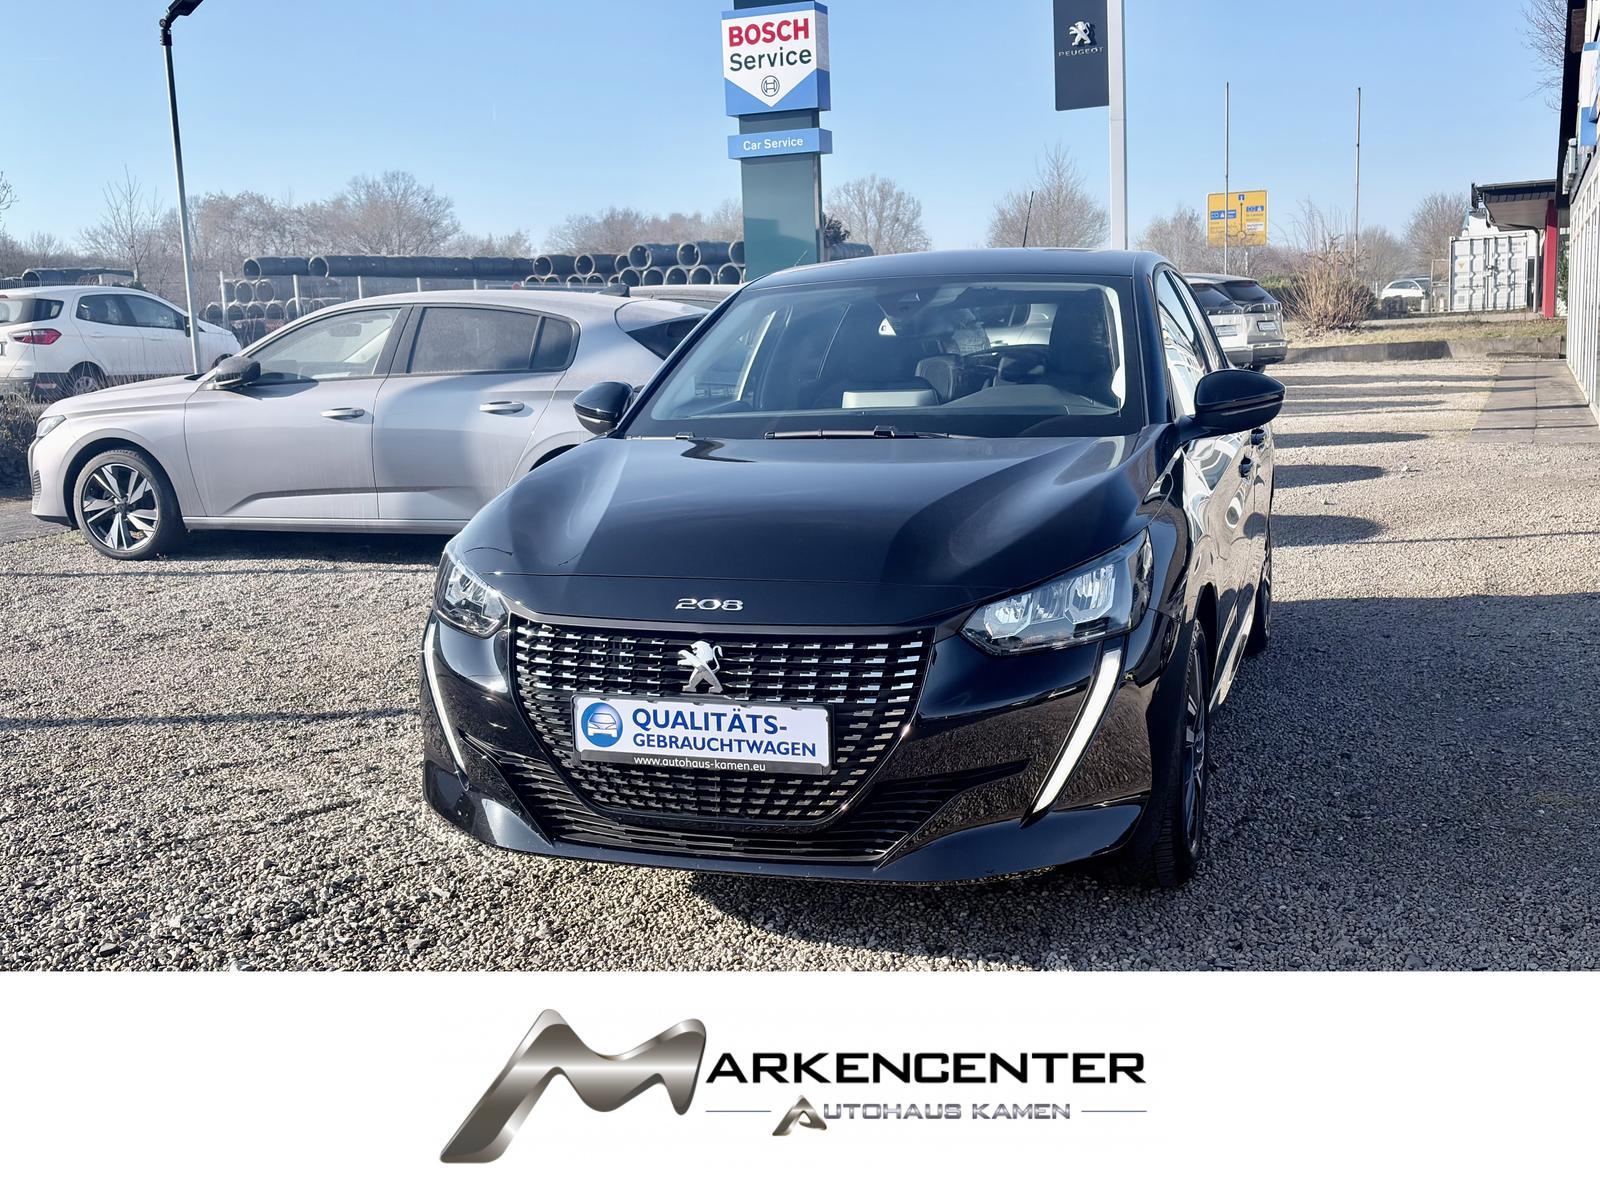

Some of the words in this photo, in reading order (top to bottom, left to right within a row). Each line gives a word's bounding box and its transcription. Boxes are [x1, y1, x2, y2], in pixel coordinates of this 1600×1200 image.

[728, 18, 809, 47] BOSCH
[729, 46, 812, 72] Service
[1058, 46, 1104, 57] PEUGEOT
[743, 140, 761, 151] Car
[764, 137, 804, 149] Service
[675, 598, 743, 611] 208
[632, 707, 788, 735] QUALITÄTS-
[633, 732, 817, 757] GEBRAUCHTWAGEN
[633, 755, 766, 772] www.autohaus-kamen.eu
